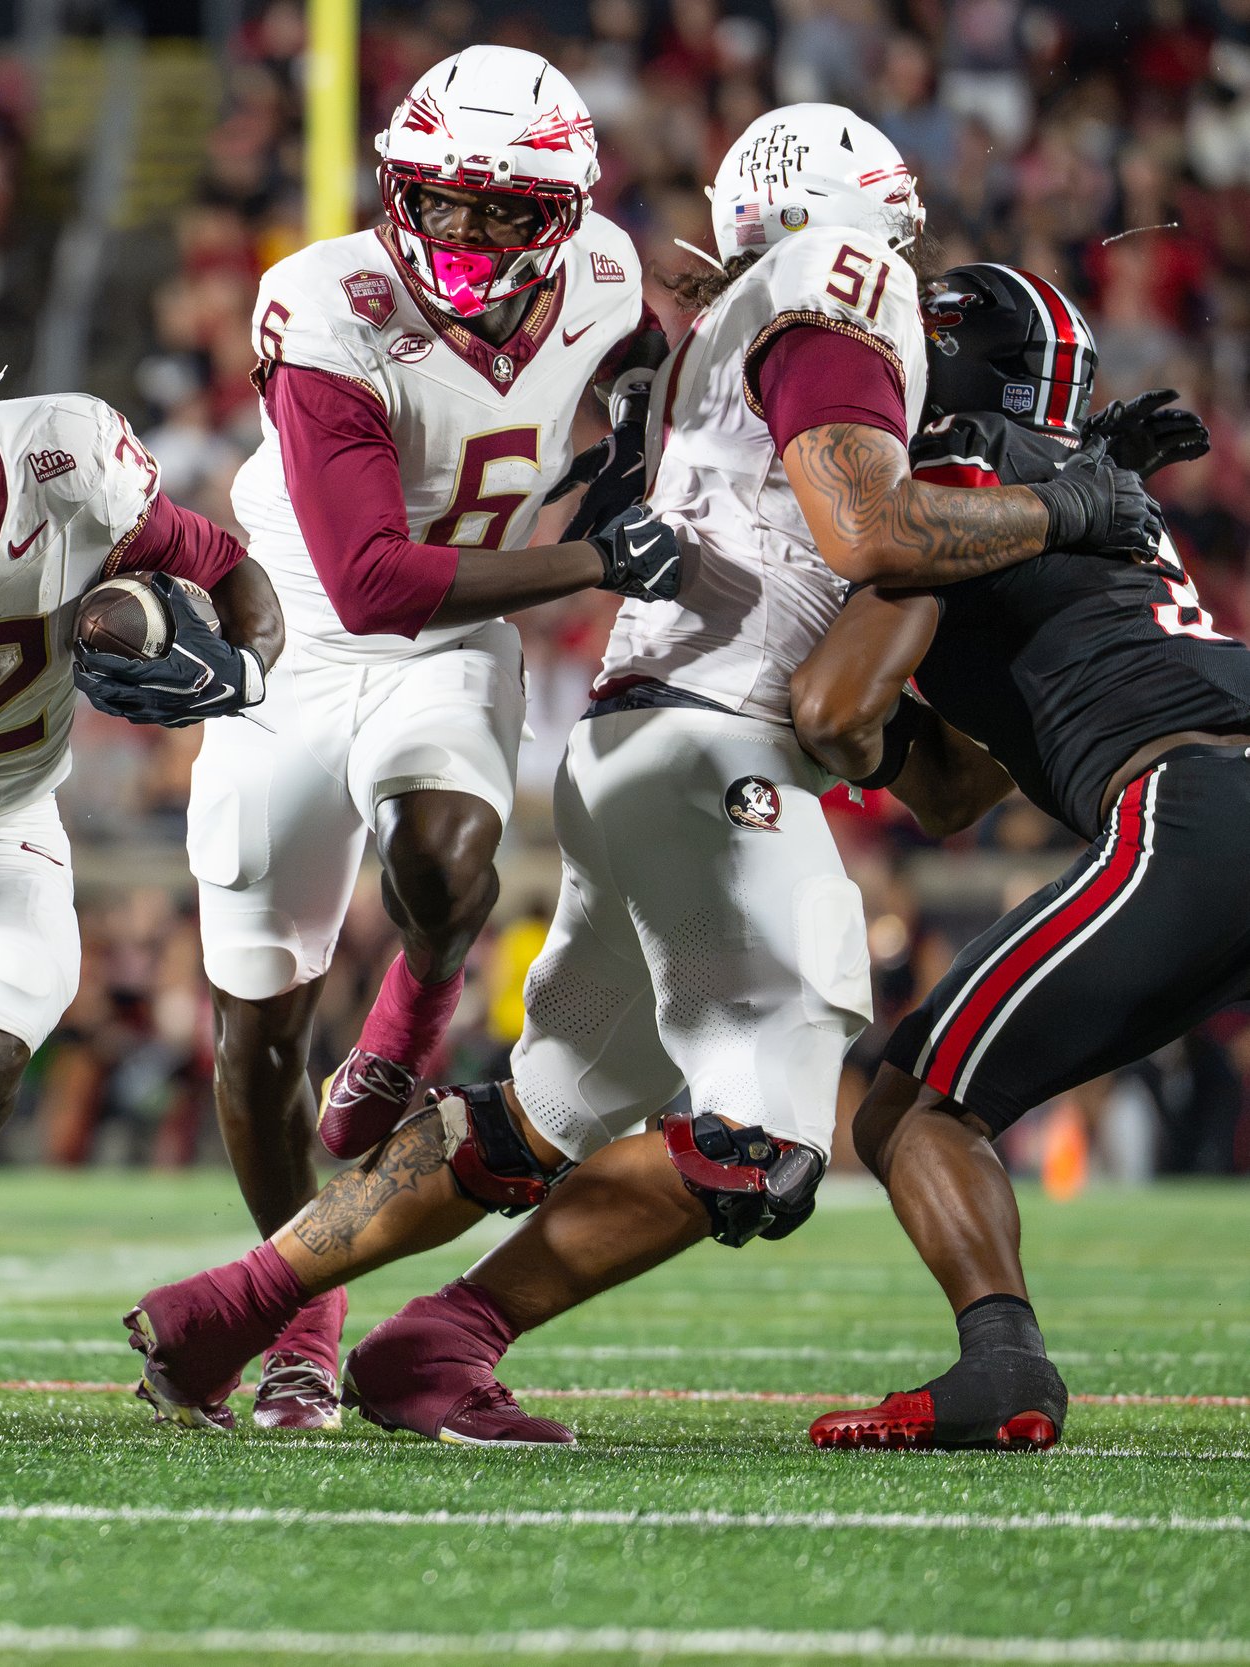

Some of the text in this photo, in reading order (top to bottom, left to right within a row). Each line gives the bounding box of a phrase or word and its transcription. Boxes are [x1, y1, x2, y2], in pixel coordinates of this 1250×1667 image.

[592, 252, 623, 274] kin.
[824, 243, 892, 323] 51
[260, 299, 294, 362] 6
[393, 338, 427, 355] ACC
[1007, 387, 1030, 396] USA
[1005, 399, 1031, 407] 250
[29, 451, 72, 474] kin.
[38, 460, 75, 481] insurance
[418, 424, 542, 551] 6
